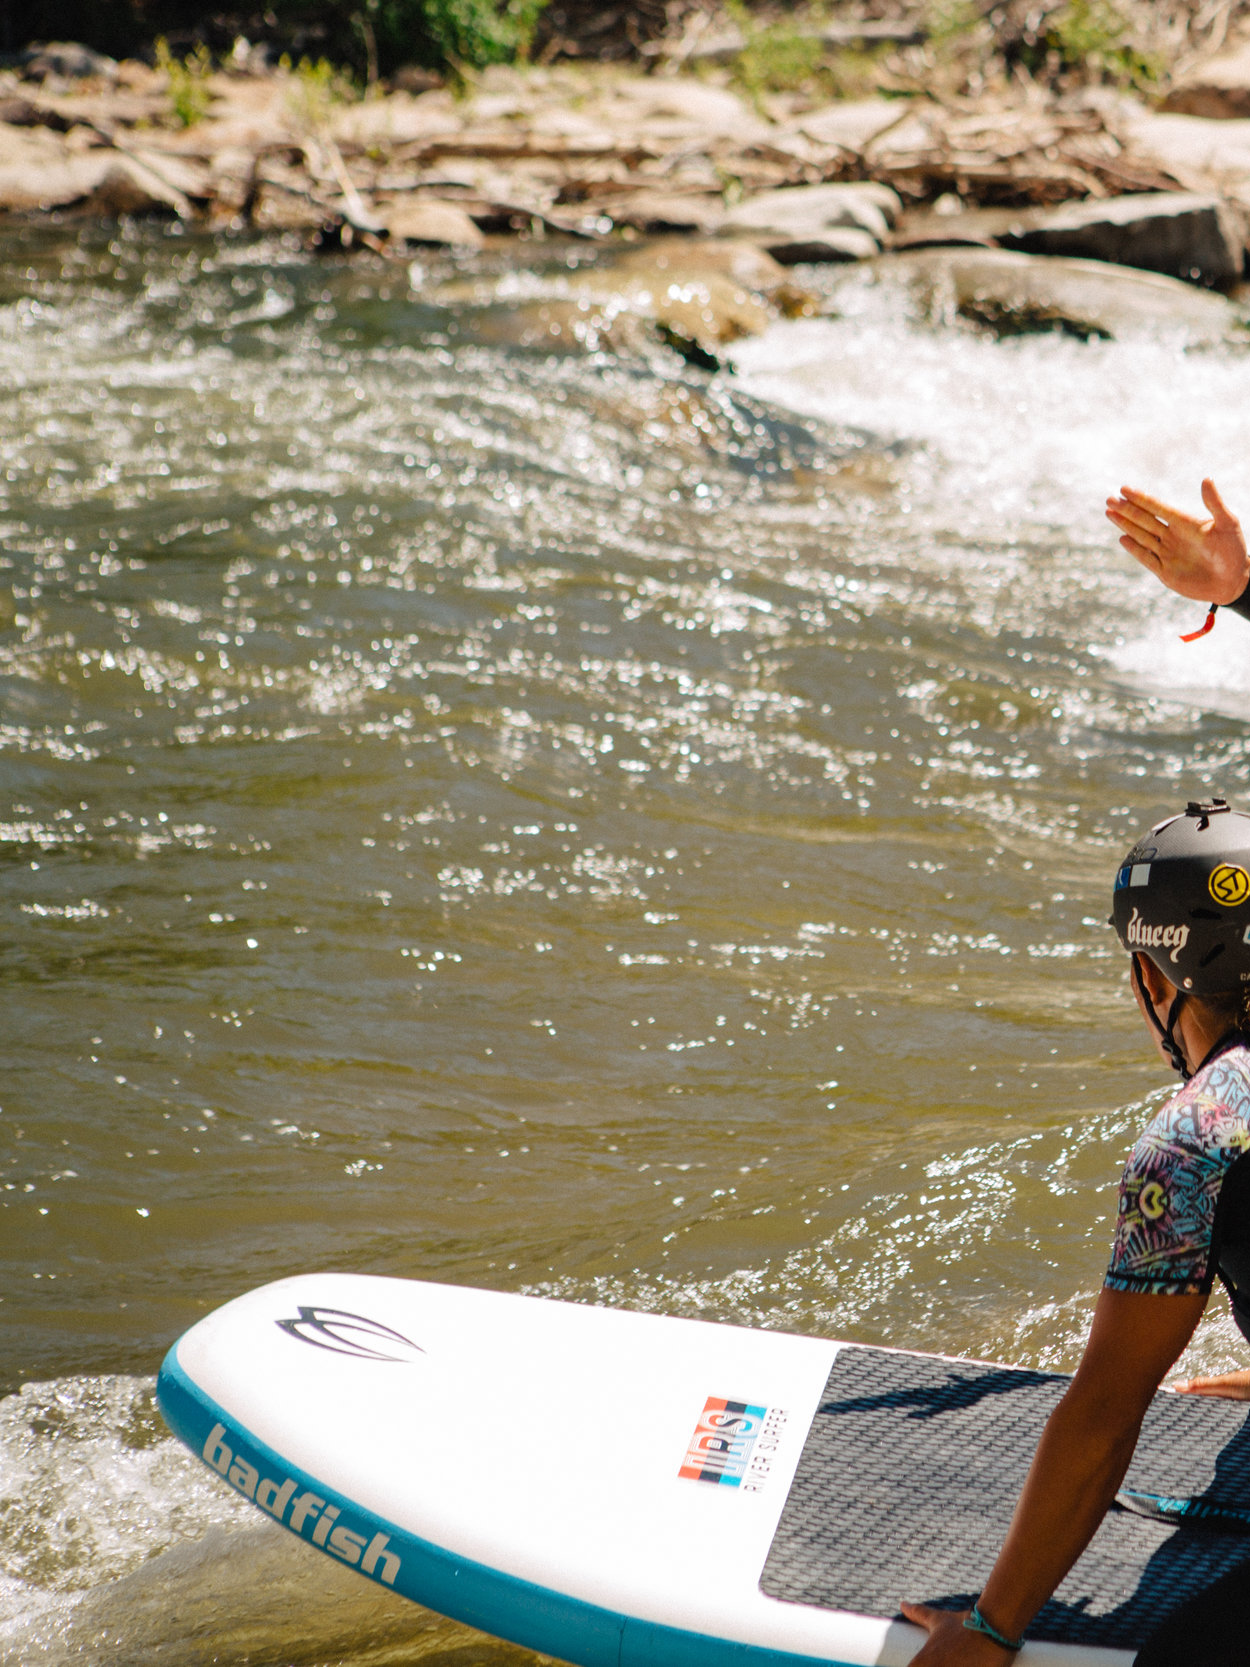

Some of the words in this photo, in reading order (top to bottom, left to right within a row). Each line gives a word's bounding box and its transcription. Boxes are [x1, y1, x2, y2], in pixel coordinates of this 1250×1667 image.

[685, 1408, 763, 1476] IRS
[758, 1407, 791, 1452] SURFER
[743, 1455, 774, 1494] RIVER
[202, 1422, 401, 1586] badfish
